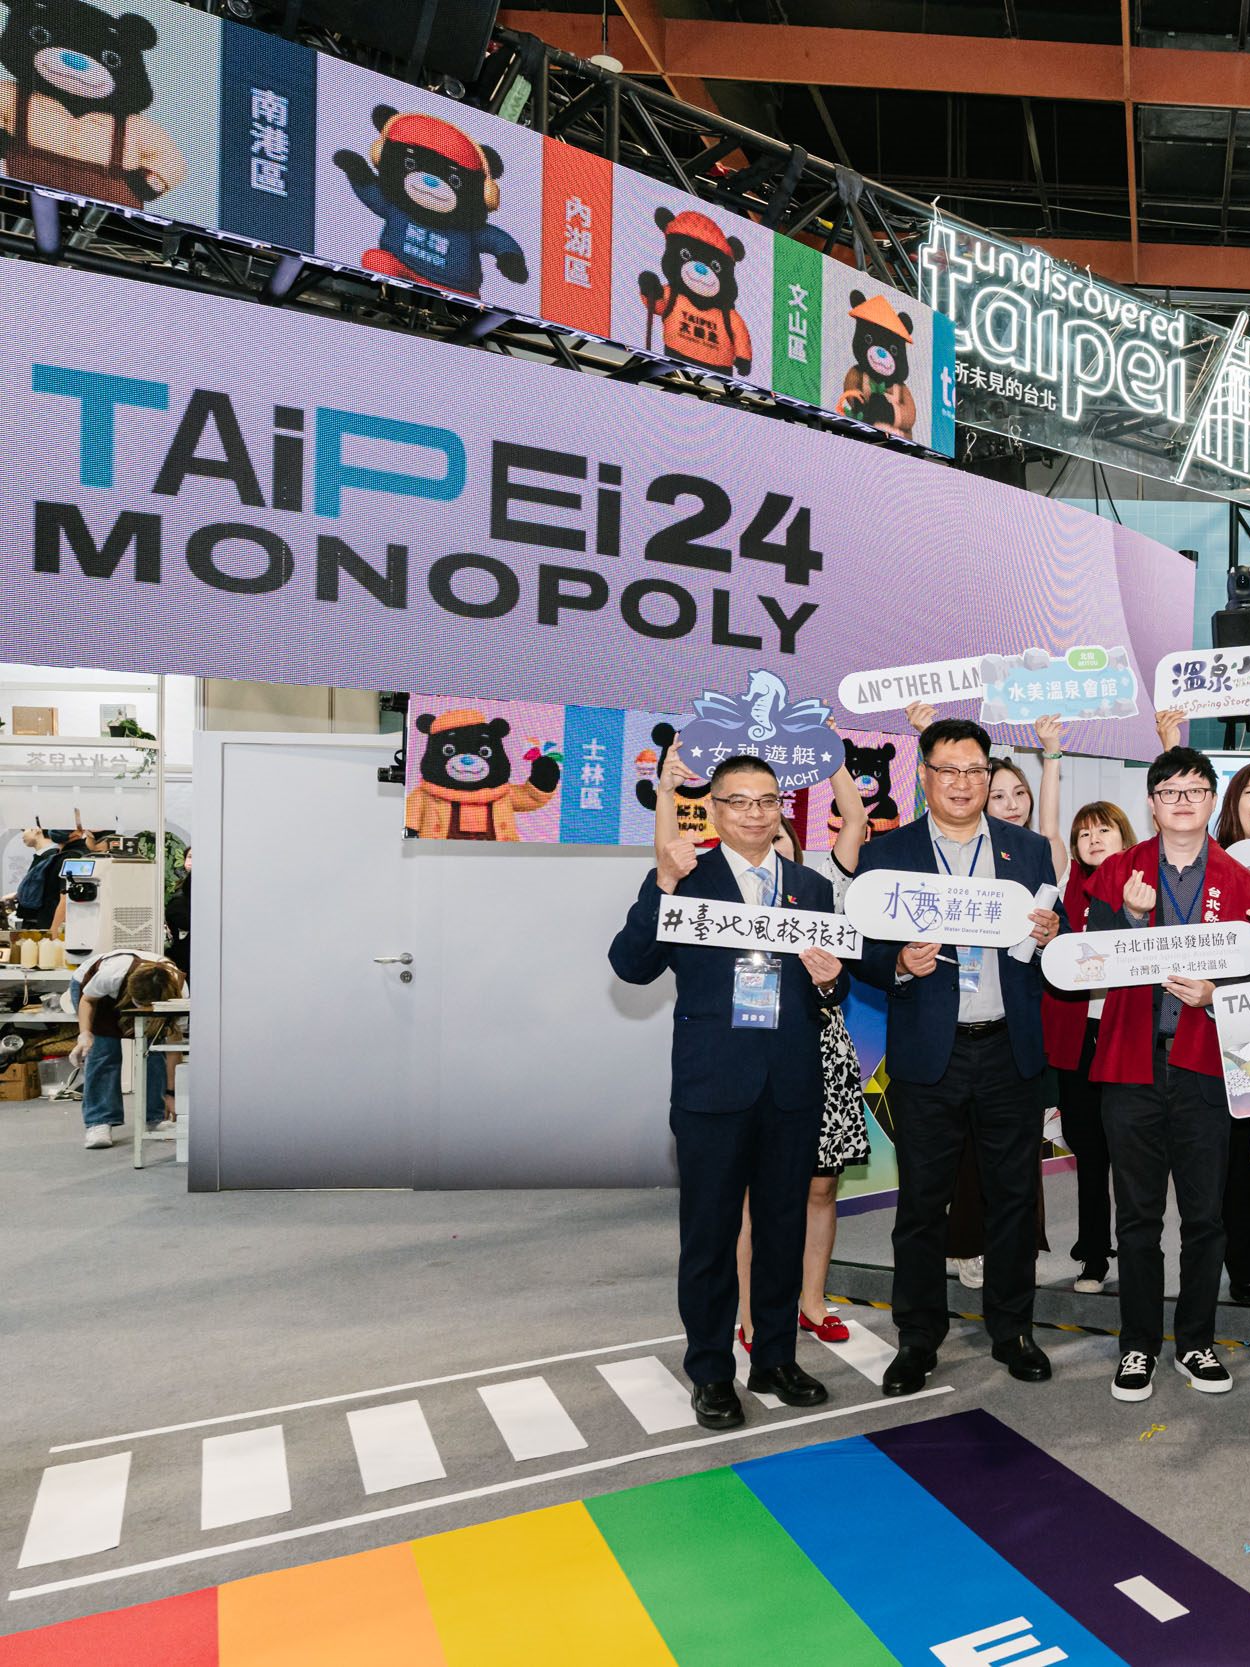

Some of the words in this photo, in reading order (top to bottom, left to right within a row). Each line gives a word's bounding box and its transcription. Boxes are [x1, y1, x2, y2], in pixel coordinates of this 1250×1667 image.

[249, 87, 289, 196] 南港區
[564, 196, 592, 288] 內湖區
[787, 283, 810, 363] 文山區
[923, 225, 1185, 423] taipei
[975, 241, 1185, 347] undiscovered
[33, 501, 818, 655] MONOPOLY
[1008, 678, 1118, 702] 水美溫泉會館
[1189, 699, 1221, 713] Spring
[1224, 696, 1250, 706] Store
[580, 738, 605, 810] 士林區
[777, 769, 819, 788] YACHT
[944, 898, 1002, 924] 嘉年華
[977, 890, 1004, 898] TAIPEI
[1114, 931, 1238, 954] 台北市溫泉發展協會
